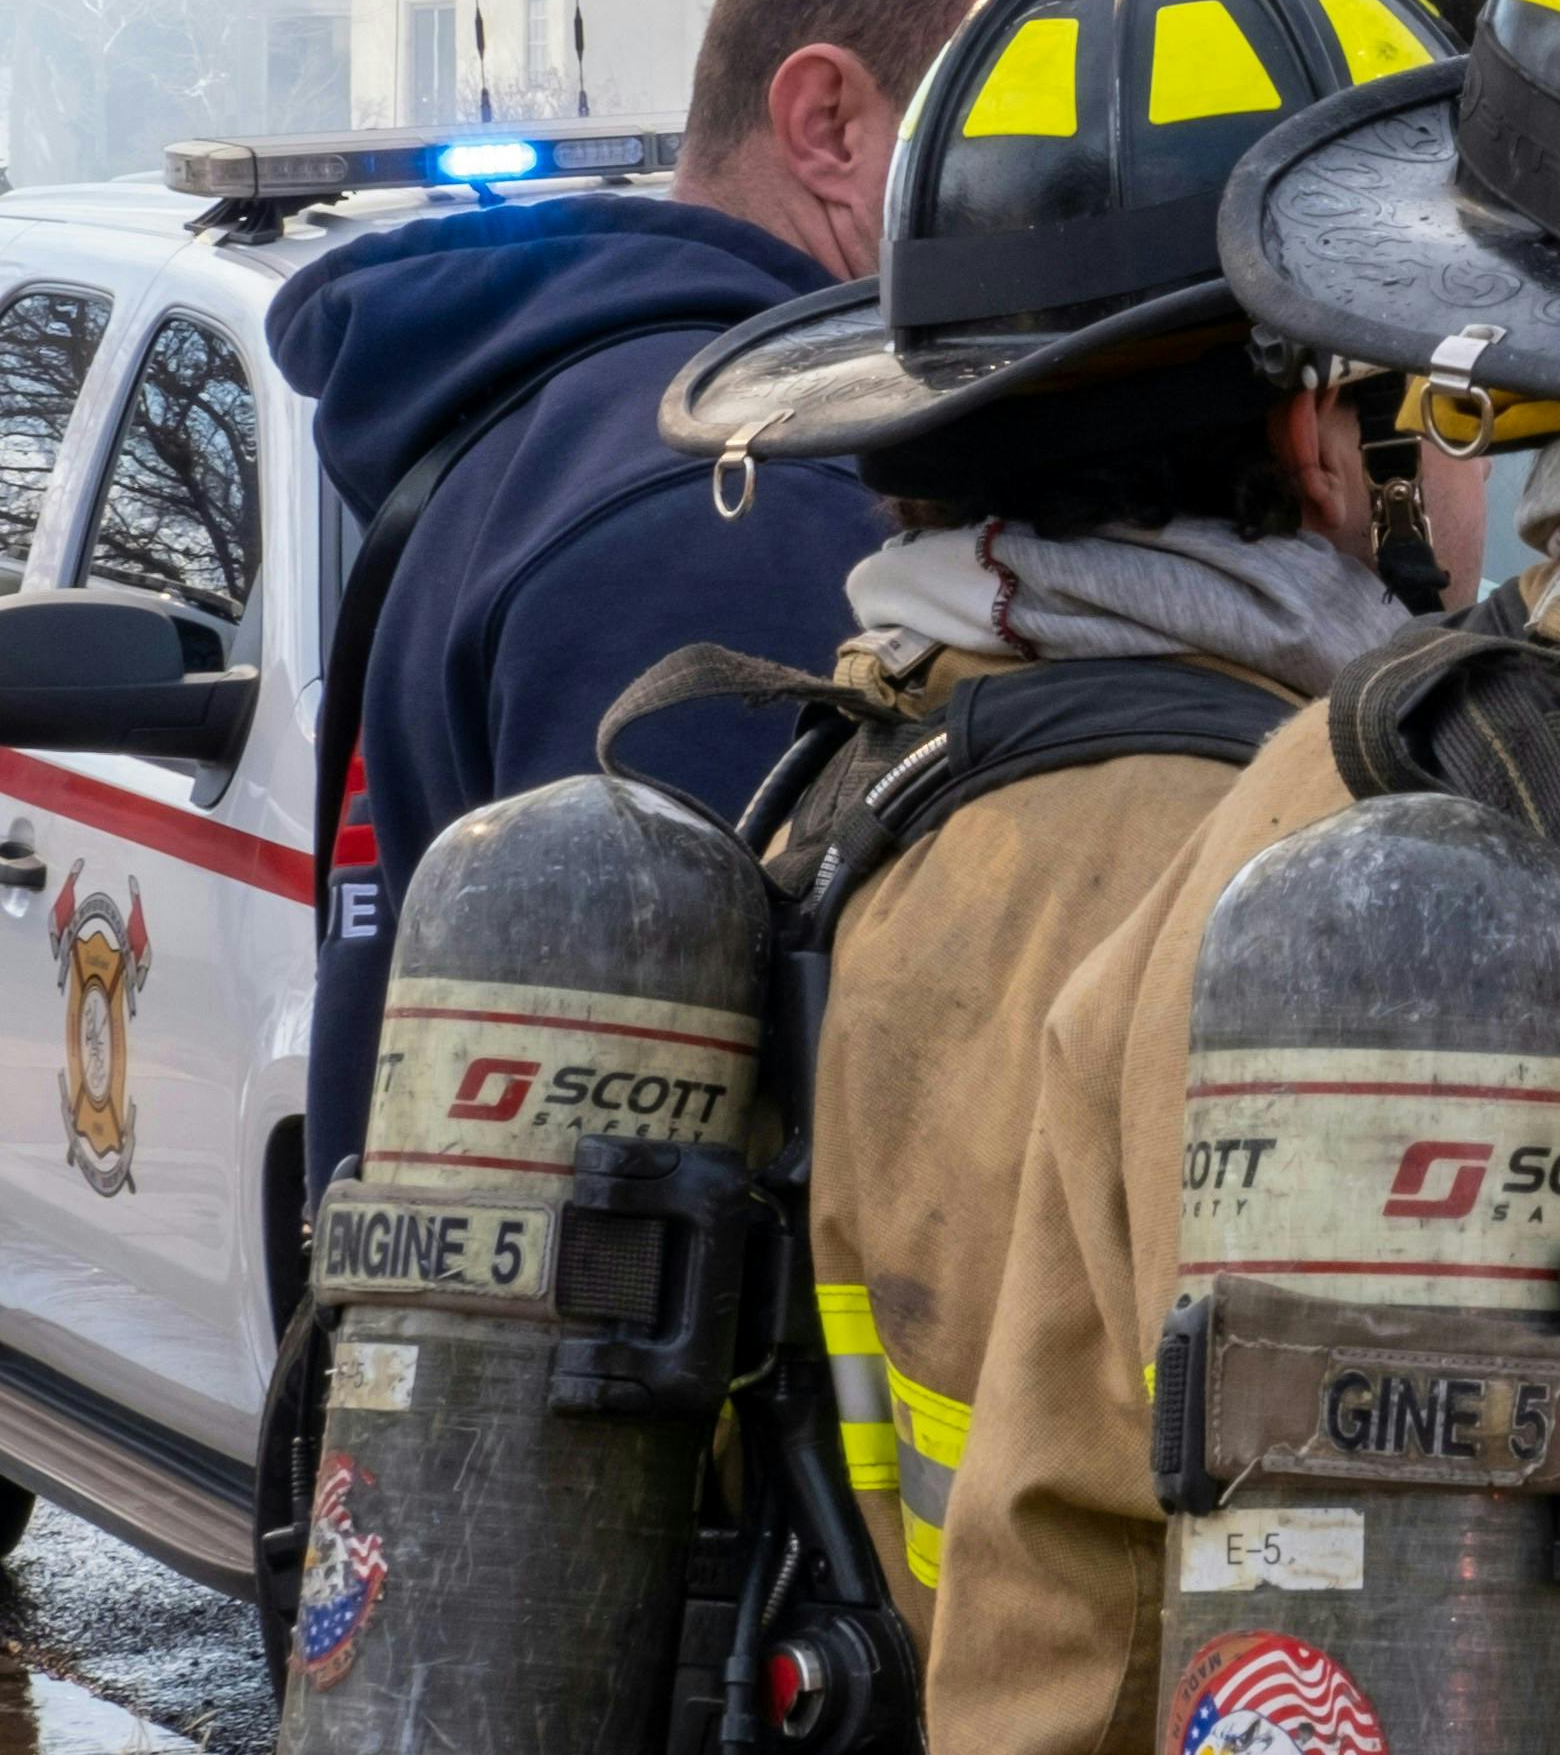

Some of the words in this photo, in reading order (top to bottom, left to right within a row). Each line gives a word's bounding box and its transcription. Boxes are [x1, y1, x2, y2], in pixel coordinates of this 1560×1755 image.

[544, 1065, 728, 1124] SCOTT
[1183, 1137, 1278, 1190] OTT
[325, 1209, 469, 1284] ENGINE
[490, 1220, 525, 1285] 5
[1327, 1368, 1485, 1460] GINE
[1509, 1381, 1550, 1461] 5
[1226, 1532, 1282, 1566] E-5
